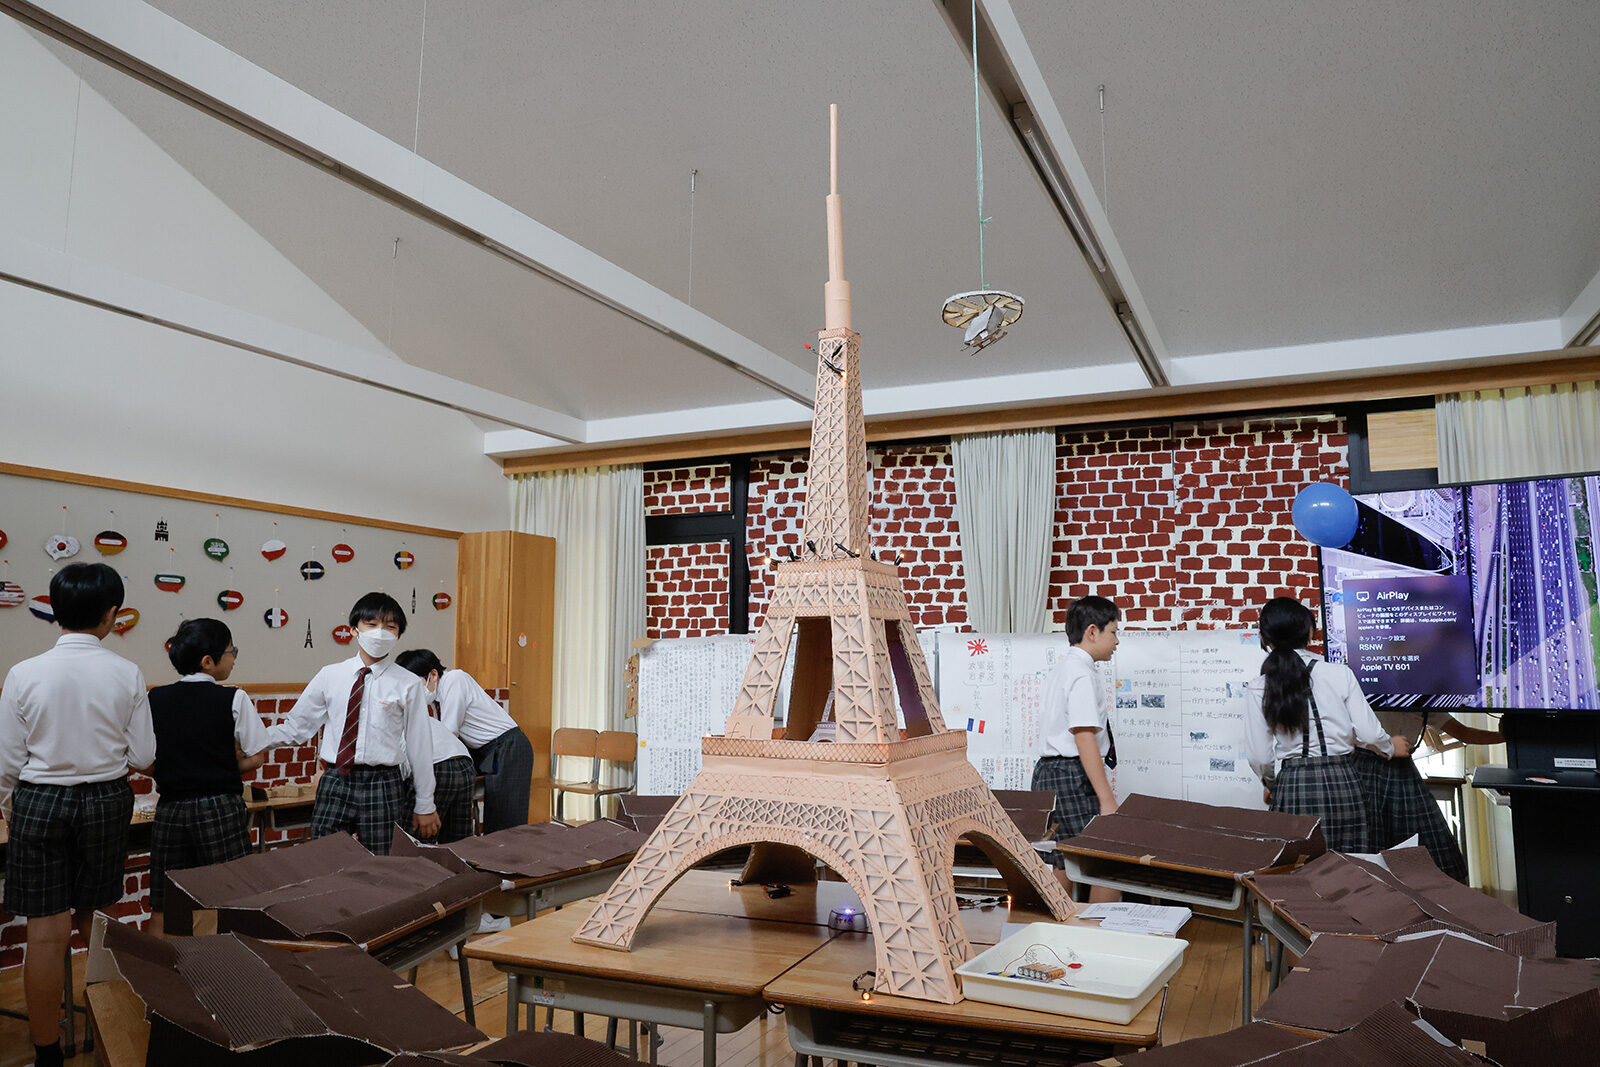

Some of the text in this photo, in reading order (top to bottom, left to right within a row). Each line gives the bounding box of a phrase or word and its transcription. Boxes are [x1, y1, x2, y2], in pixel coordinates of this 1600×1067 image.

[1376, 591, 1410, 601] AirPlay
[1359, 643, 1383, 651] RSNW
[1360, 663, 1382, 671] Apple
